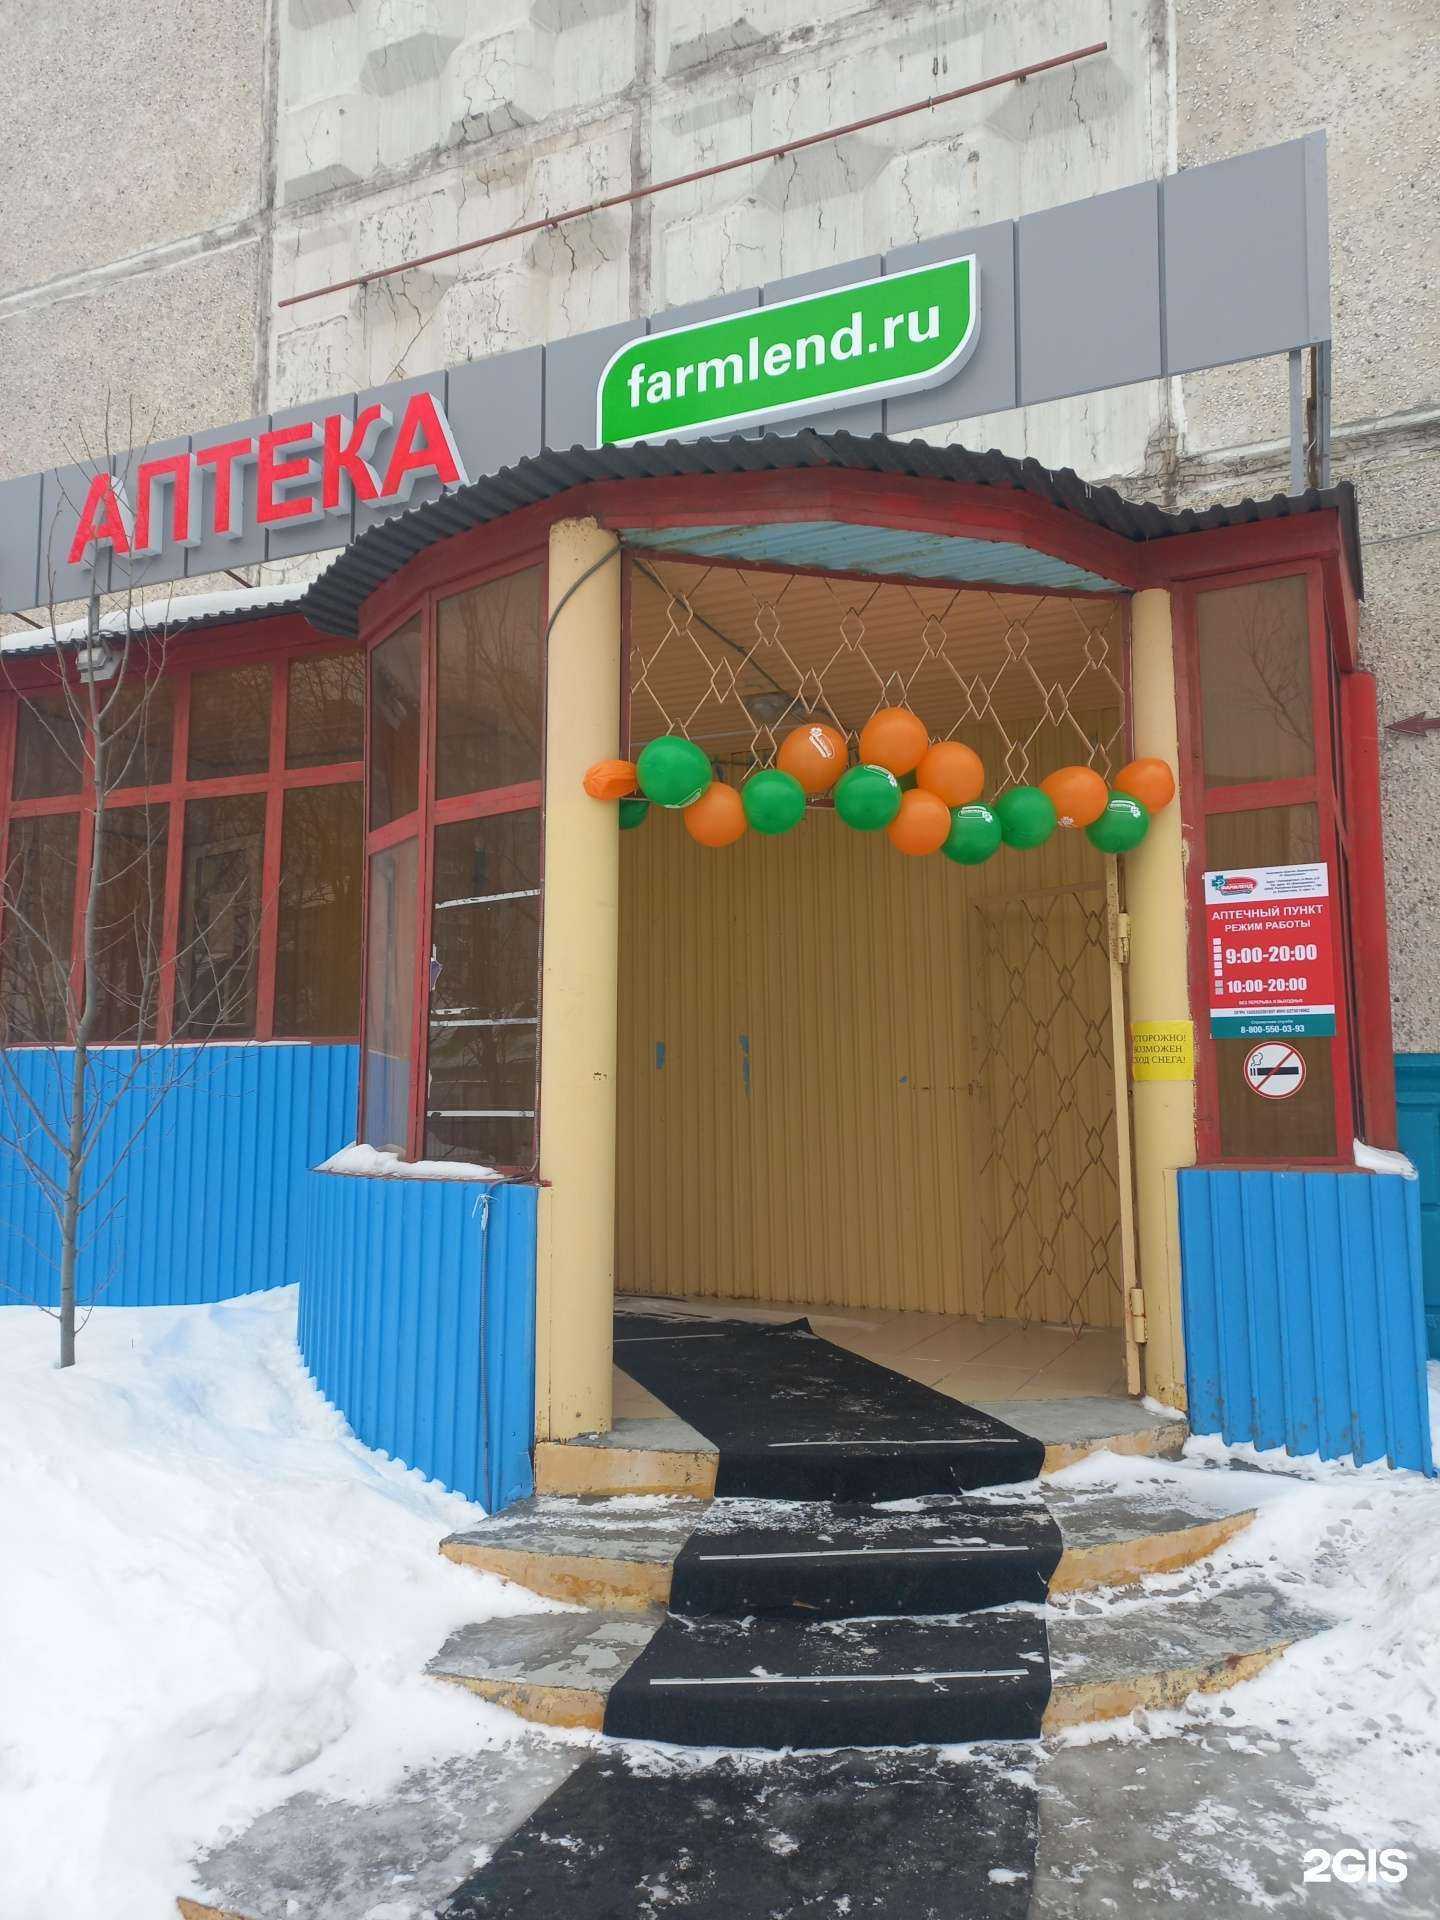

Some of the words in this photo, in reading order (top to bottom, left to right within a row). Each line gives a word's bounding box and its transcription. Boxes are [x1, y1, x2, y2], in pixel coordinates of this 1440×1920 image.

[627, 306, 940, 408] farmlend.ru
[67, 392, 464, 564] АПТЕКА
[1212, 905, 1280, 920] АПТЕЧНЫЙ
[1283, 904, 1324, 917] ПУНКТ
[1224, 923, 1263, 932] РЕЖИМ
[1265, 920, 1311, 930] РАБОТЫ
[1225, 944, 1318, 964] 9:00-20:00
[1226, 978, 1308, 993] 10:00-20:00
[1240, 1025, 1305, 1034] 8-800-550-03-93
[1133, 1033, 1186, 1042] СТОРОЖНО!
[1151, 1055, 1186, 1064] СНЕГА!
